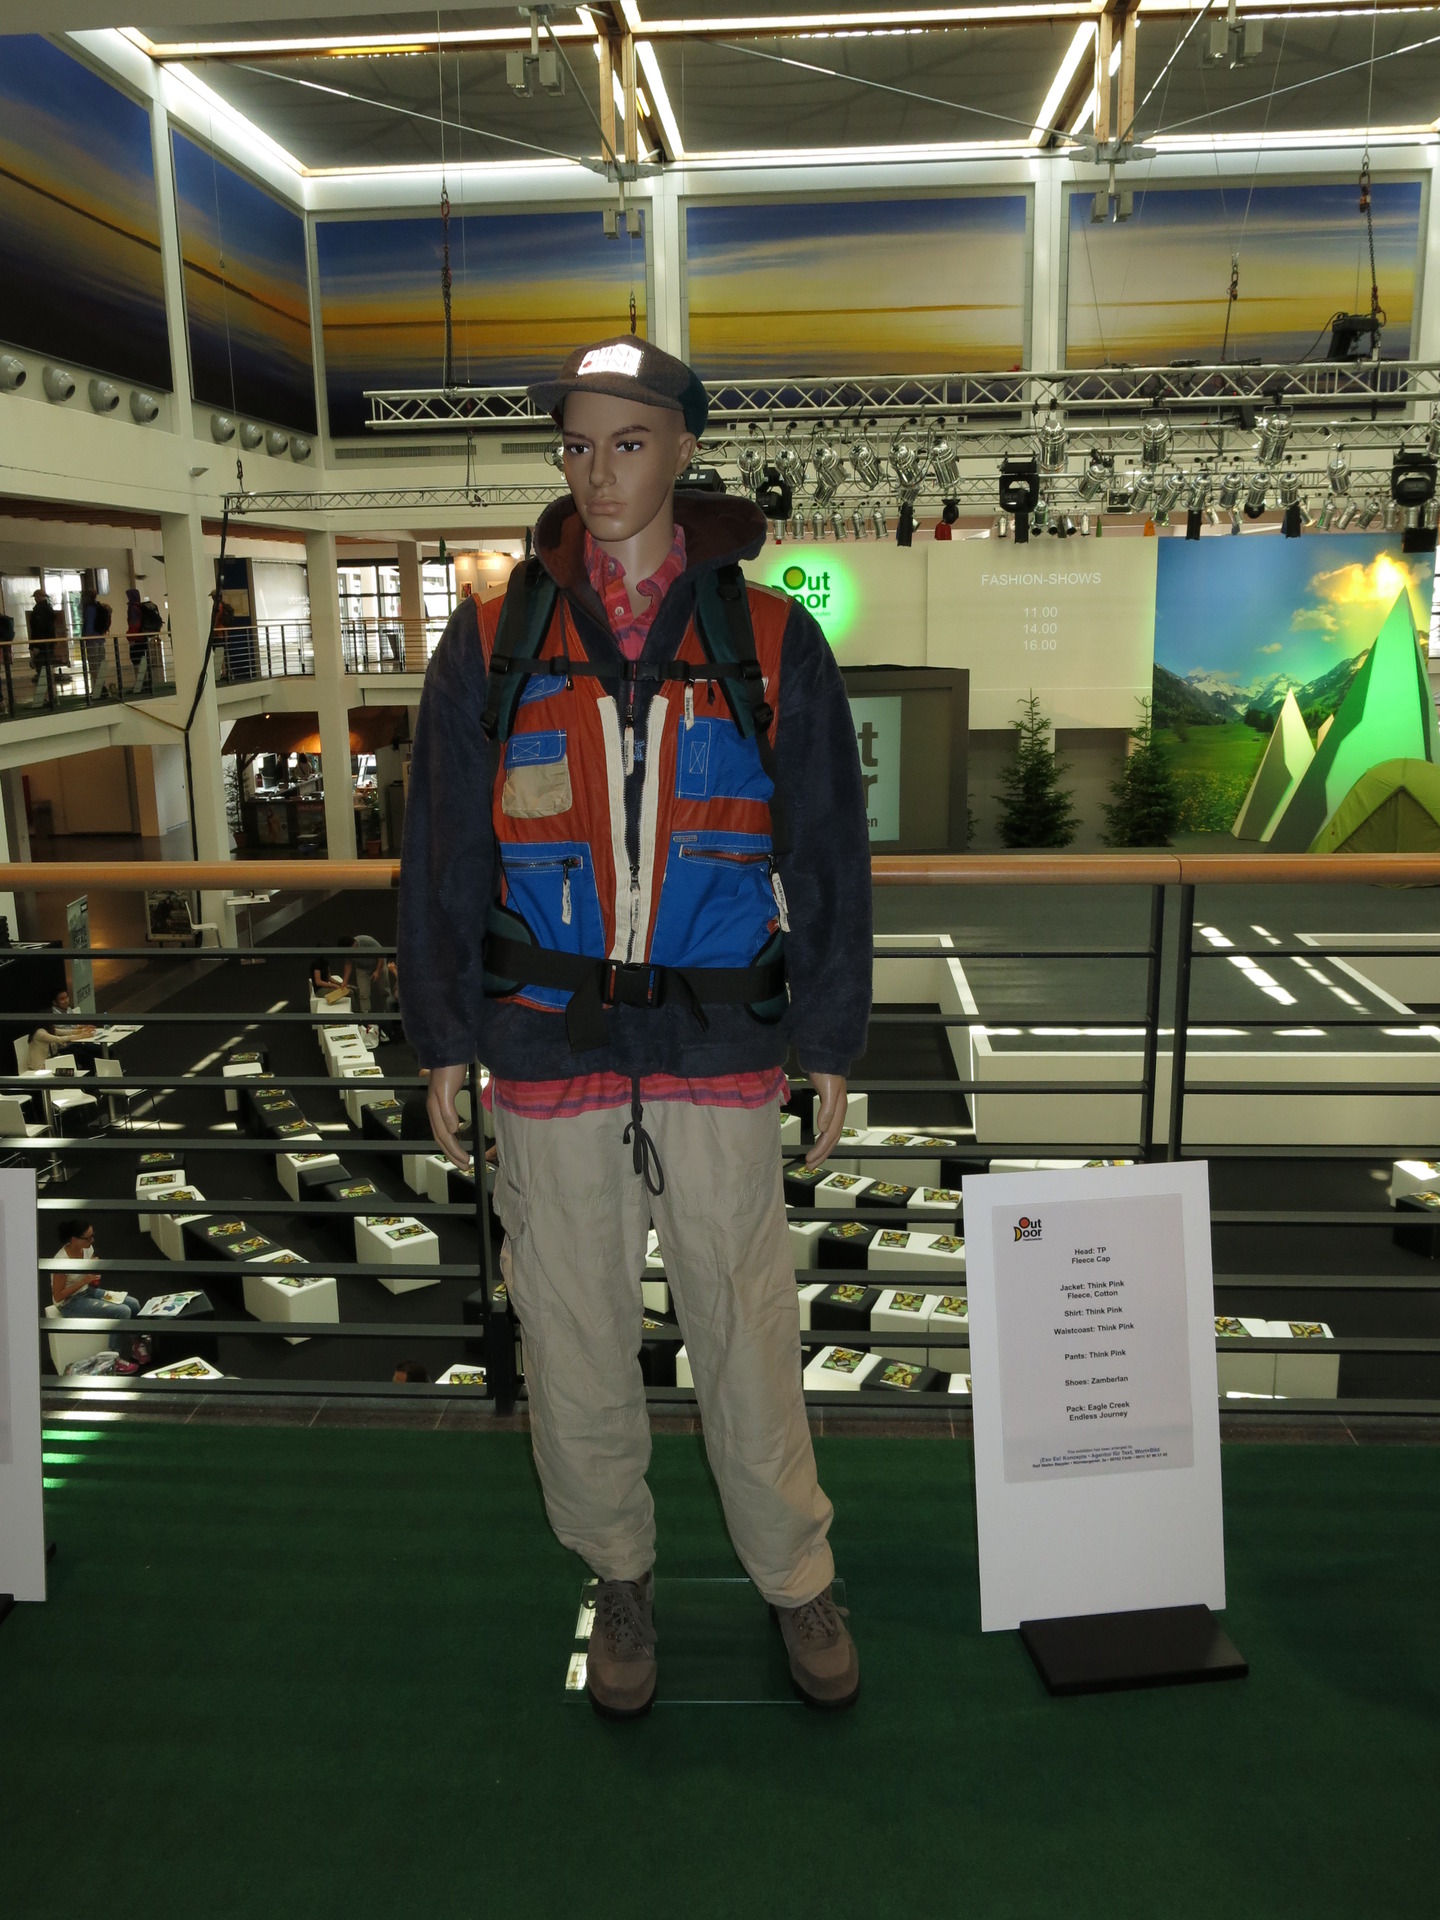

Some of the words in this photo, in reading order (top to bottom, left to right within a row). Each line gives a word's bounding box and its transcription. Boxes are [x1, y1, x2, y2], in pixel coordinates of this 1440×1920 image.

[782, 566, 831, 591] Out
[981, 572, 1102, 586] FASHION-SHOWS
[1023, 606, 1058, 618] 11.00
[1023, 622, 1058, 634] 14.00
[1023, 639, 1057, 651] 16.00
[1018, 1216, 1042, 1229] Out
[1013, 1226, 1042, 1242] Door
[1097, 1246, 1107, 1254] TP
[1096, 1255, 1111, 1263] Cap
[1087, 1281, 1107, 1289] Think
[1094, 1290, 1118, 1298] Cotton
[1064, 1309, 1084, 1317] Shirt:
[1085, 1307, 1106, 1315] Think
[1106, 1306, 1123, 1314] Pink
[1097, 1323, 1118, 1332] Think
[1118, 1322, 1135, 1330] Pink
[1089, 1350, 1109, 1358] Think
[1110, 1349, 1127, 1357] Pink
[1064, 1379, 1090, 1387] Shoes:
[1091, 1375, 1129, 1385] Zamberlan
[1066, 1405, 1087, 1413] Pack:
[1088, 1403, 1108, 1411] Eagle
[1109, 1401, 1130, 1409] Creek
[1069, 1413, 1098, 1421] Endless
[1099, 1410, 1128, 1419] Journey
